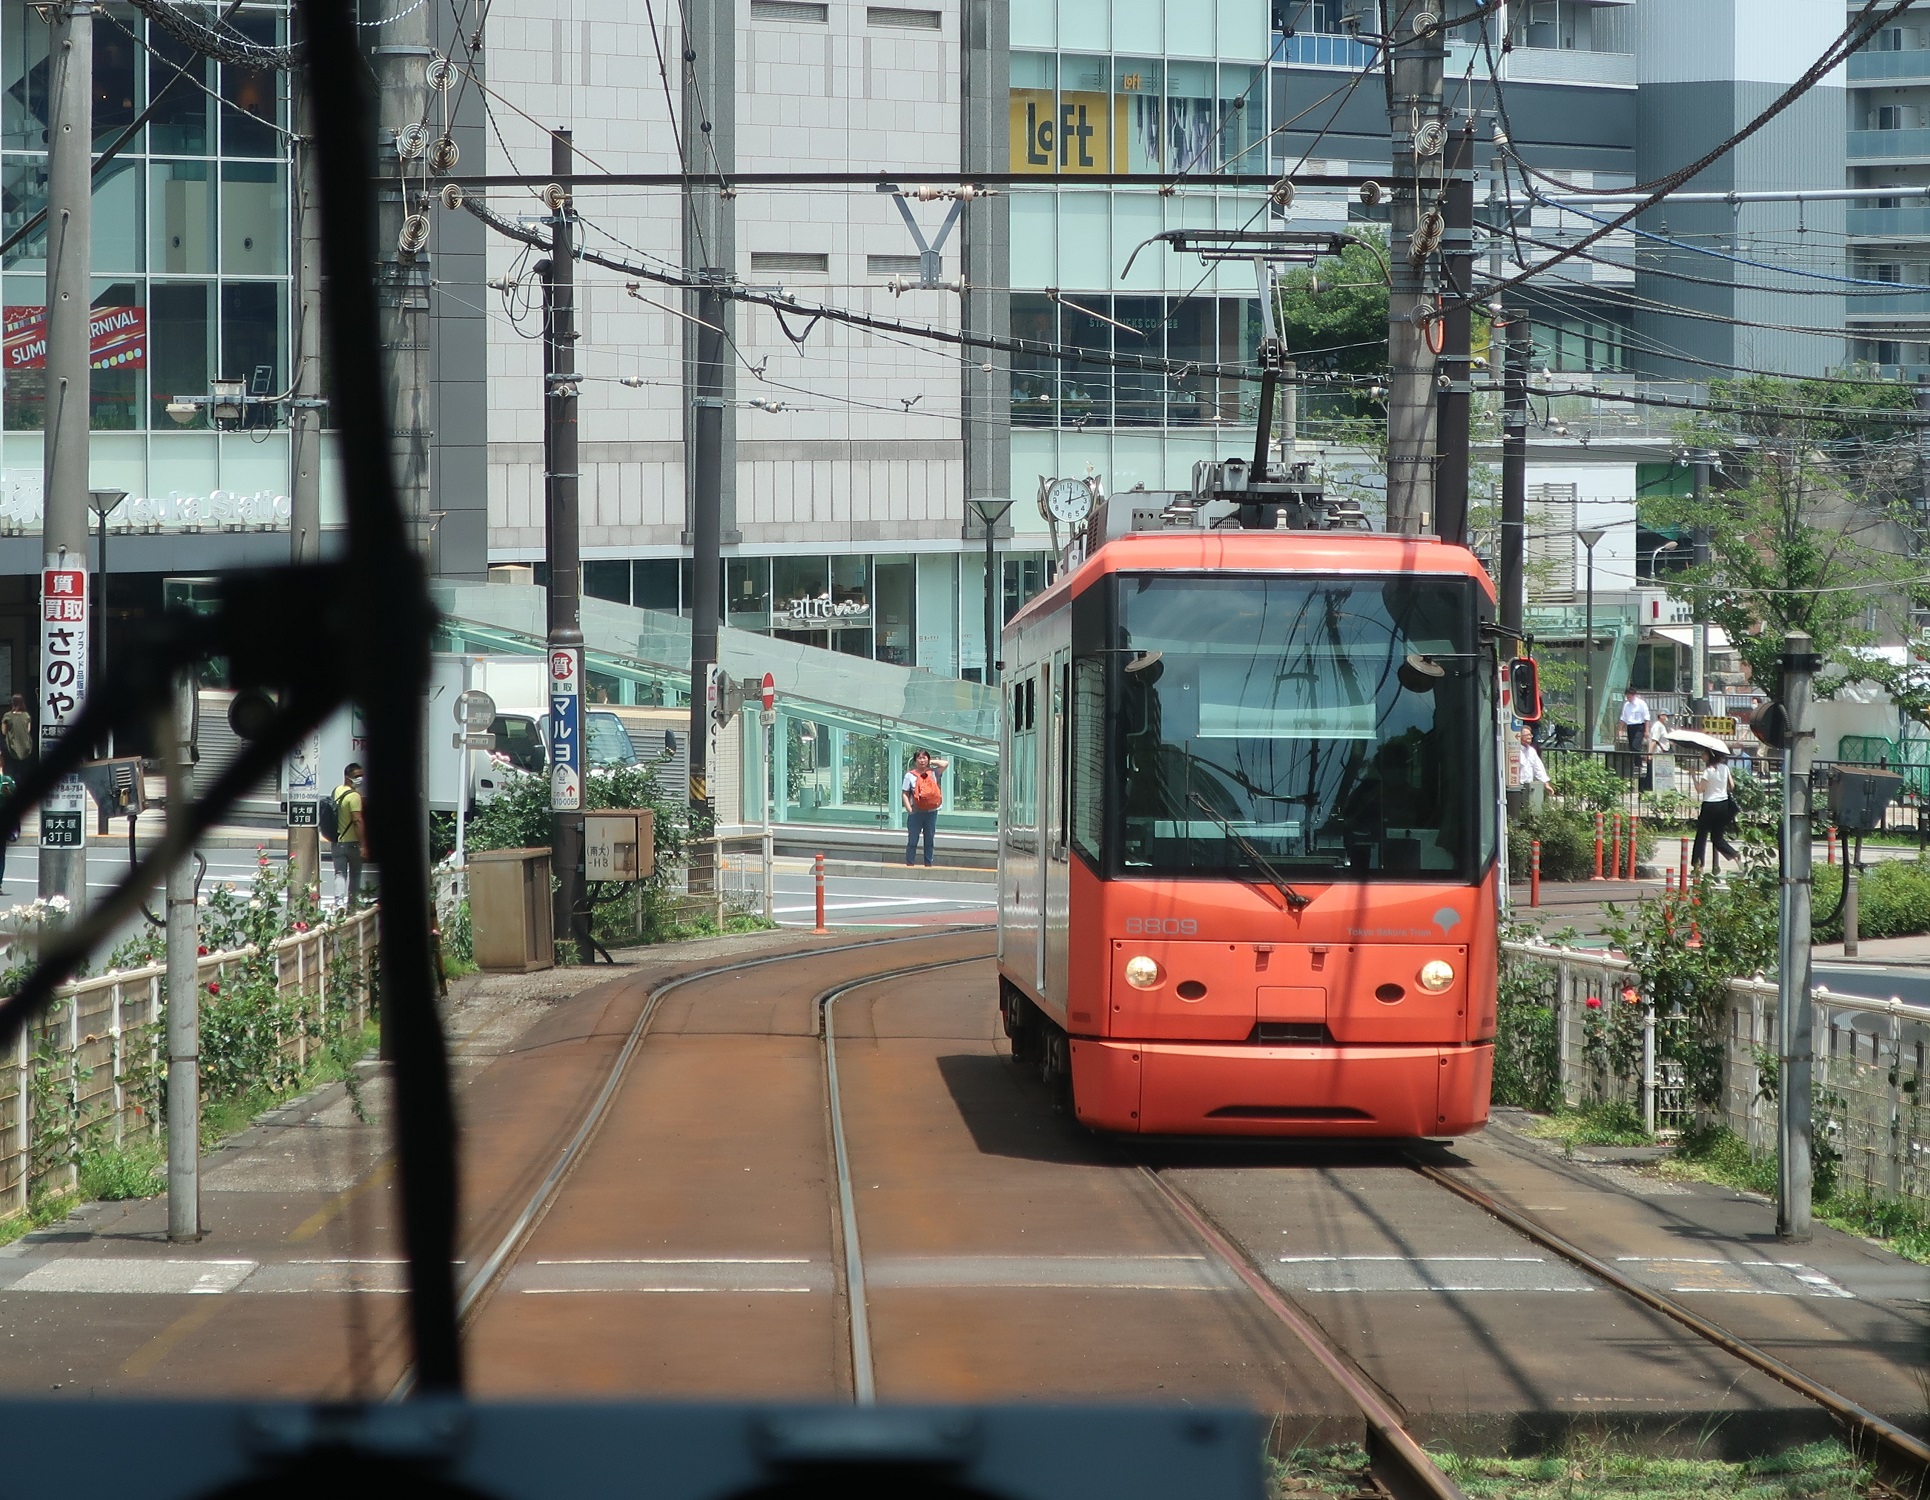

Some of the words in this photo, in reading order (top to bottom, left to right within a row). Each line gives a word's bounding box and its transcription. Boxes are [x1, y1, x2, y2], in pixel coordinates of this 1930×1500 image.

[90, 310, 139, 339] RNIVAL
[53, 575, 74, 594] 質
[45, 599, 83, 620] 買取
[46, 628, 75, 720] さのや
[553, 656, 570, 676] 質
[553, 697, 572, 762] マルヨ
[45, 819, 76, 829] 南大塚
[48, 832, 72, 842] 3丁目
[1126, 917, 1198, 935] 8809
